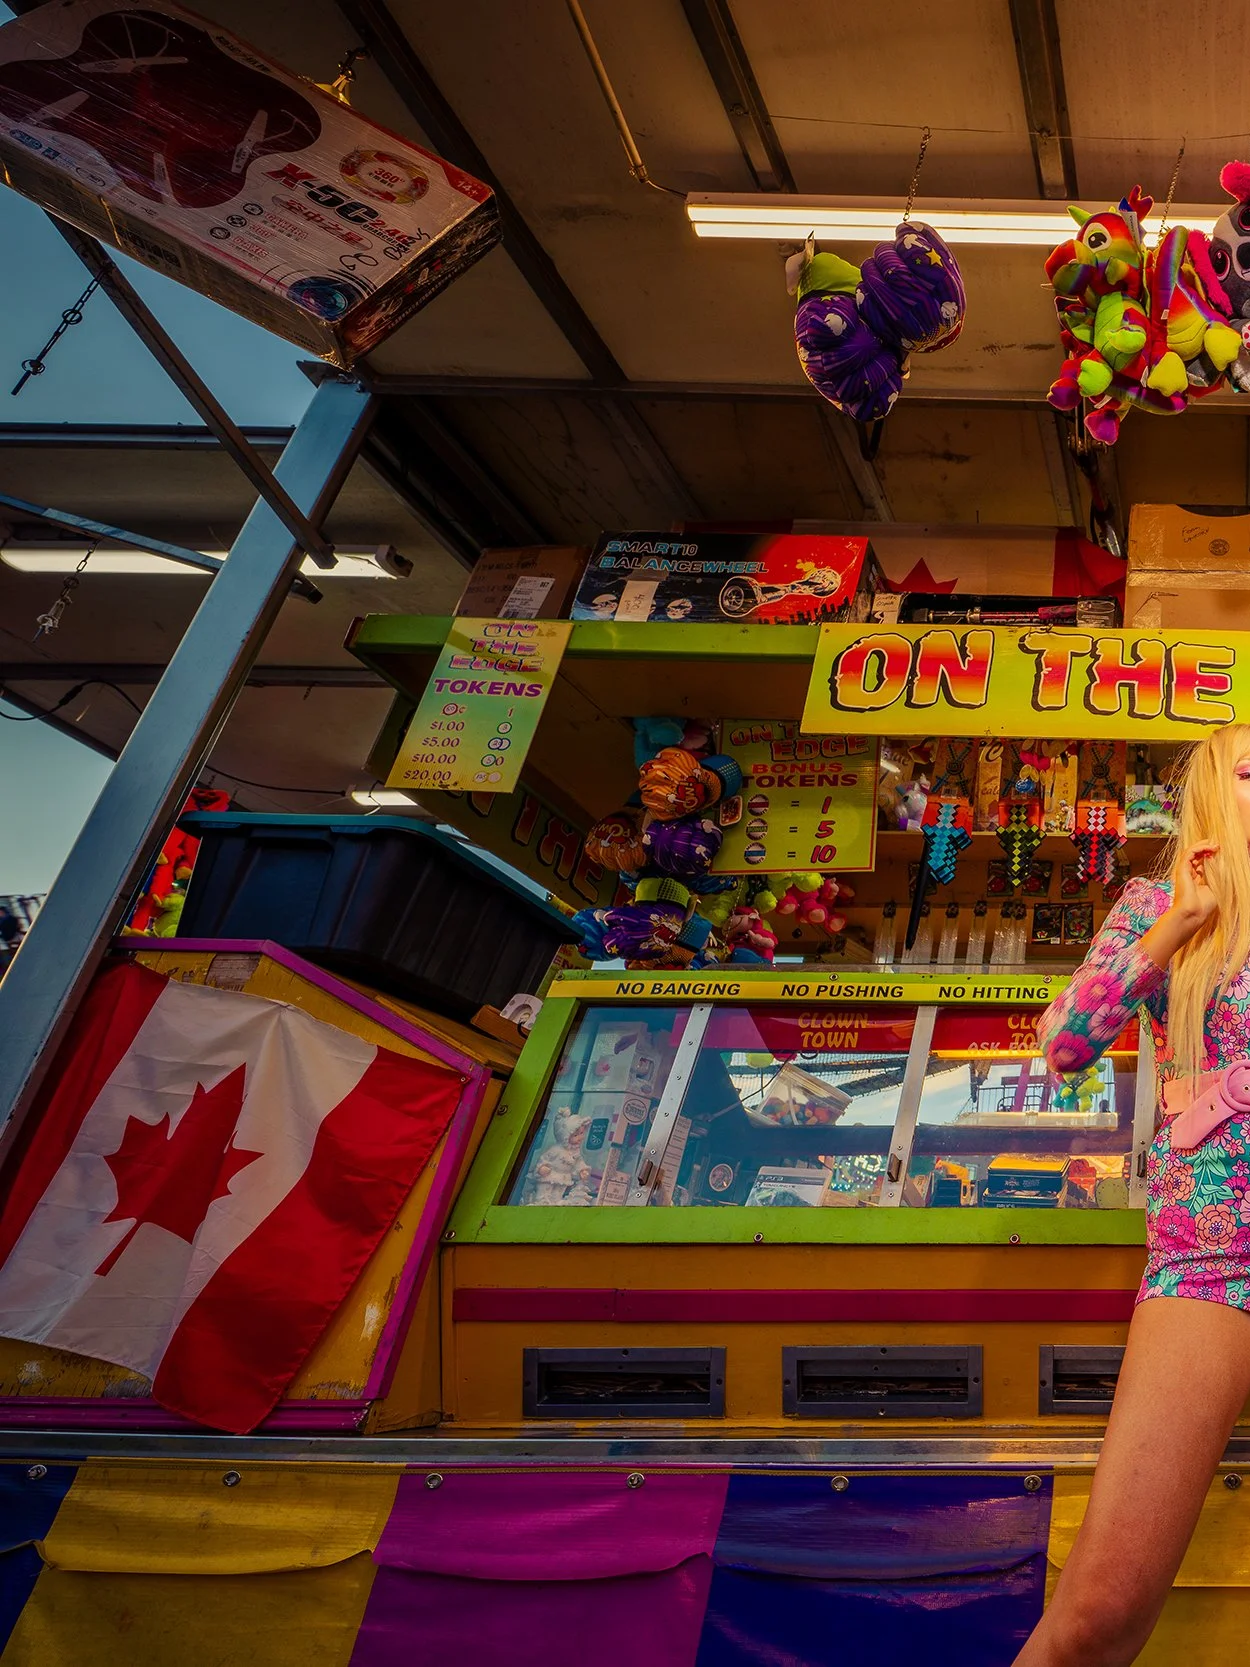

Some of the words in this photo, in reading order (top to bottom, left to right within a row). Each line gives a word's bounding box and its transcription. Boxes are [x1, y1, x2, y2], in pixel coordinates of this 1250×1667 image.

[599, 556, 769, 574] BALANCEWHEEL
[482, 623, 537, 638] ON
[471, 637, 540, 656] THE
[449, 654, 544, 673] EDGE
[829, 630, 996, 713] ON
[1018, 631, 1236, 727] THE
[434, 679, 543, 697] TOKENS
[430, 721, 465, 731] $1.00
[731, 723, 773, 746] ON
[422, 737, 460, 748] $5.00
[770, 736, 869, 761] EDGE
[412, 753, 457, 764] $10.00
[403, 770, 451, 781] $20.00
[751, 763, 844, 775] BONUS
[742, 774, 858, 788] TOKENS
[821, 796, 833, 814] 1
[815, 820, 836, 839] 5
[810, 844, 837, 863] 10
[616, 982, 646, 995] NO
[649, 982, 741, 996] BANGING
[781, 984, 808, 997] NO
[815, 984, 904, 998] PUSHING
[938, 986, 966, 999] NO
[972, 986, 1049, 999] HITTING
[798, 1012, 869, 1029] CLOWN
[801, 1031, 859, 1048] TOWN
